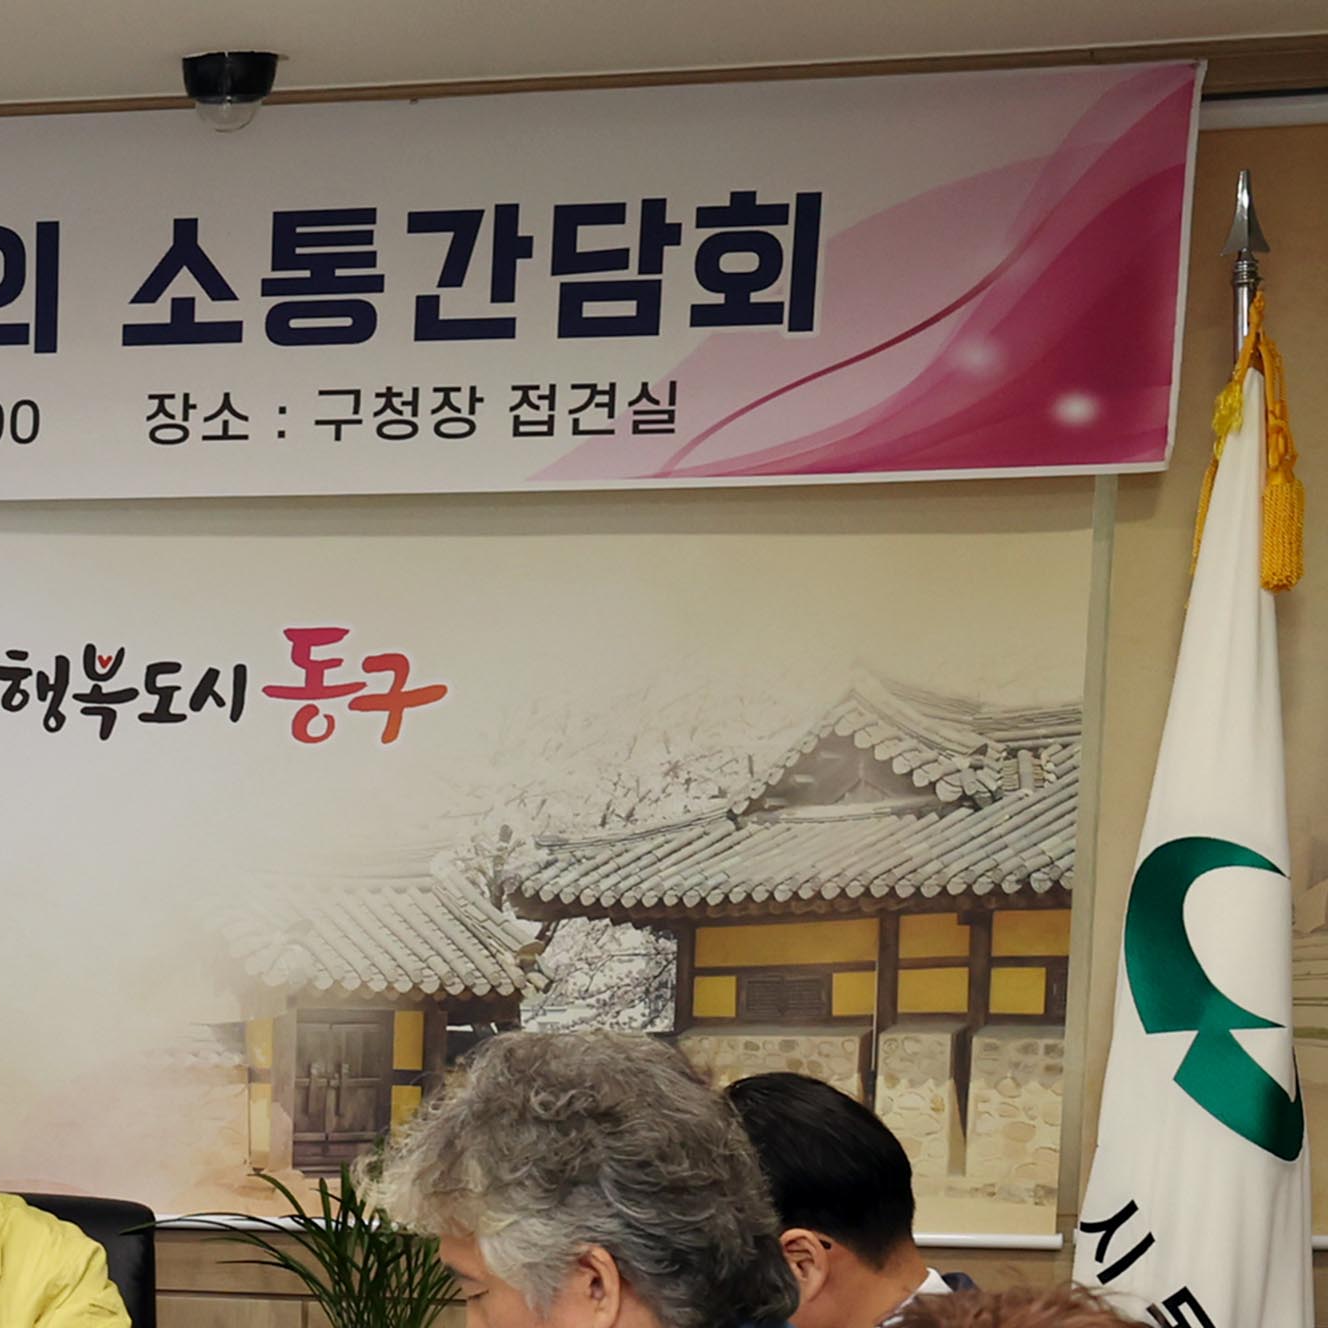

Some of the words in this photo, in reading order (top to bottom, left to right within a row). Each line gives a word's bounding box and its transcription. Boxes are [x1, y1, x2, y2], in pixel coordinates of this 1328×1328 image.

[121, 190, 823, 347] 소통간담회
[146, 391, 249, 446] 장소
[314, 385, 485, 442] 구청장
[509, 380, 678, 438] 접견실
[262, 627, 448, 744] 동구
